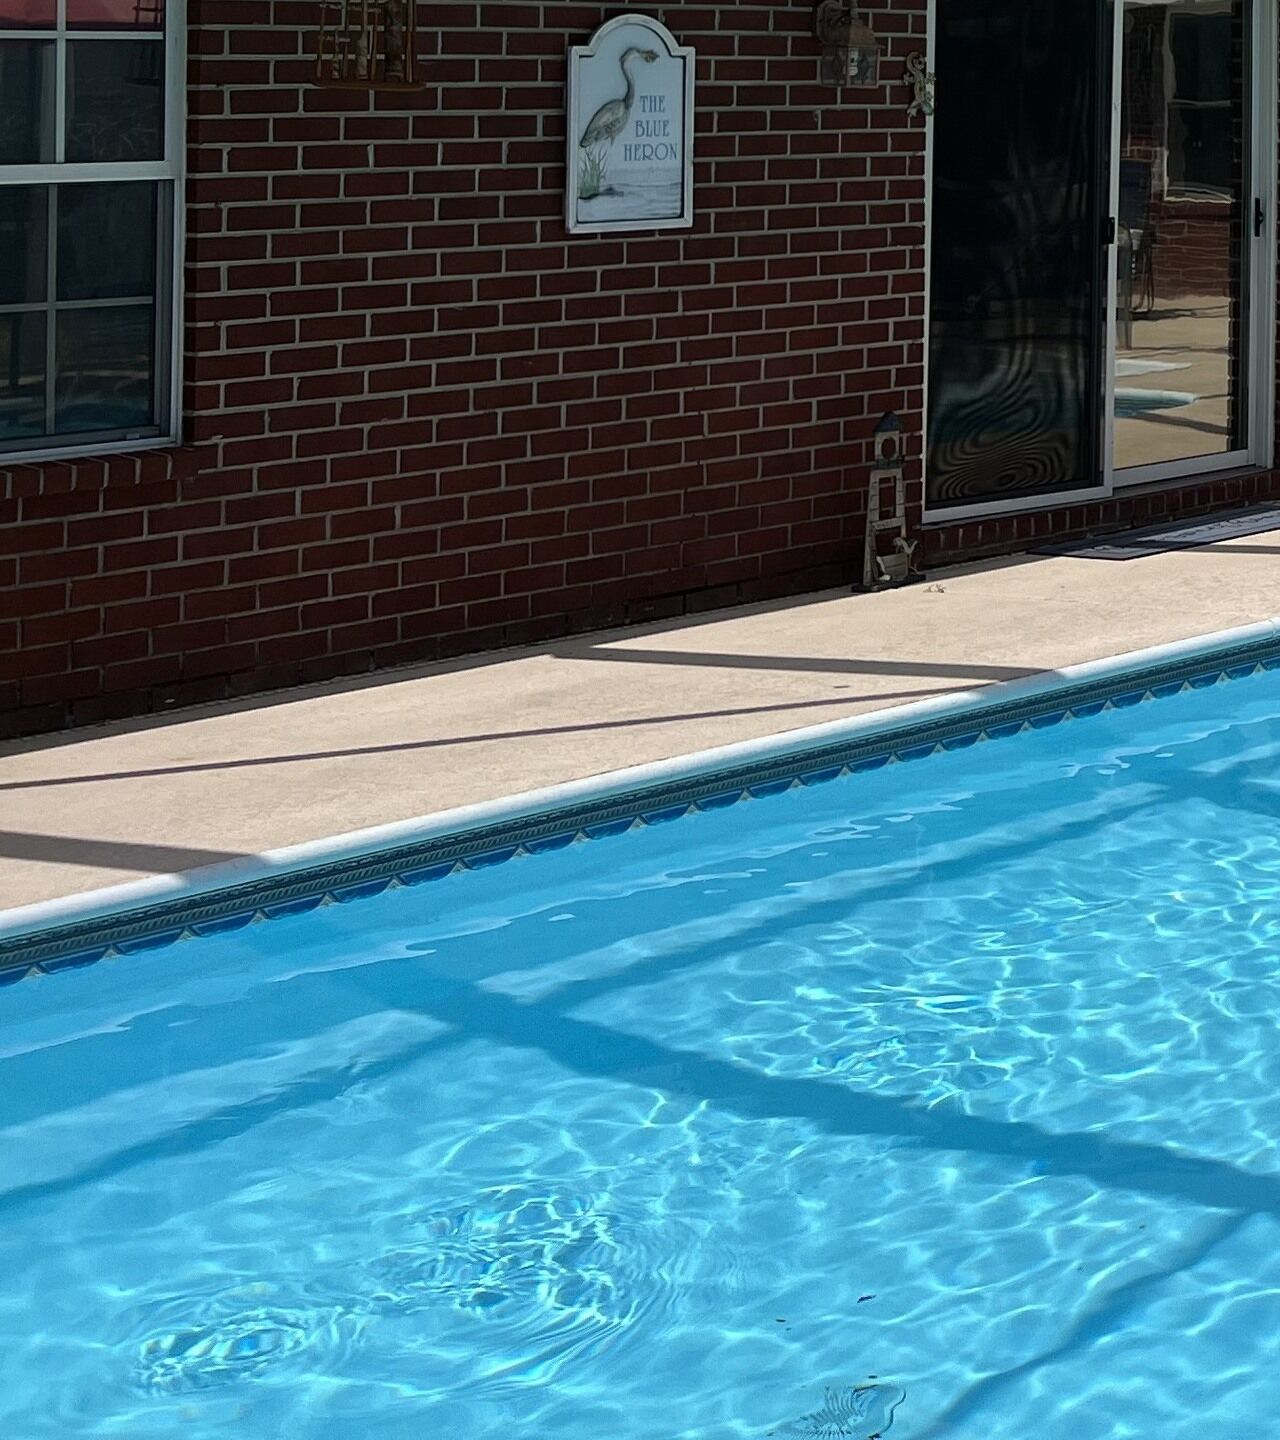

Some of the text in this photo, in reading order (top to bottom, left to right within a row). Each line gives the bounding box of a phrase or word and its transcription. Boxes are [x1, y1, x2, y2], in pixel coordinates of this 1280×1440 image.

[640, 95, 666, 113] THE
[635, 120, 670, 137] BLUE
[624, 143, 677, 161] HERON
